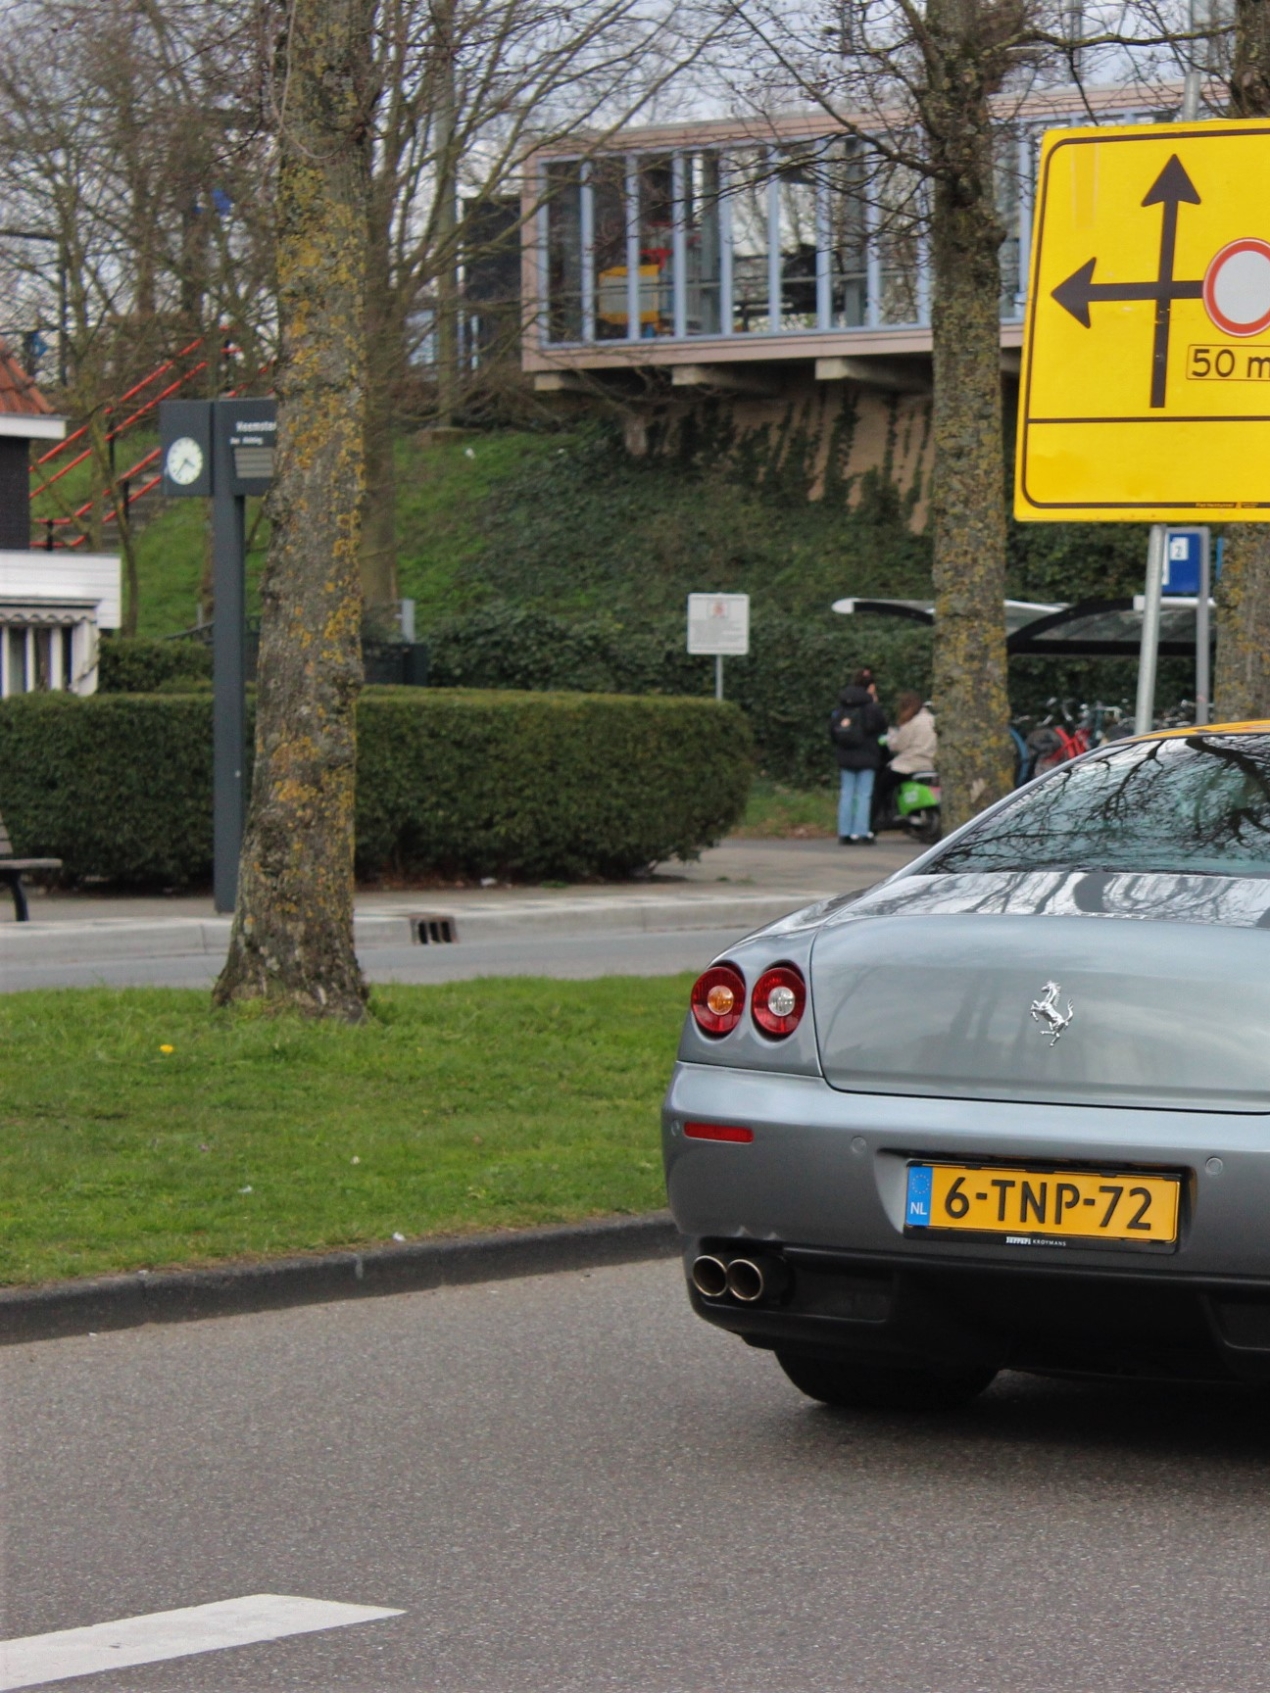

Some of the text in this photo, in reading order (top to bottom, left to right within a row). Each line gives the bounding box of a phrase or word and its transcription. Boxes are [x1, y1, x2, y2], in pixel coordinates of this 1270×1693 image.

[1191, 348, 1235, 377] 50
[910, 1201, 928, 1216] NL
[944, 1176, 1153, 1231] 6-TNP-72
